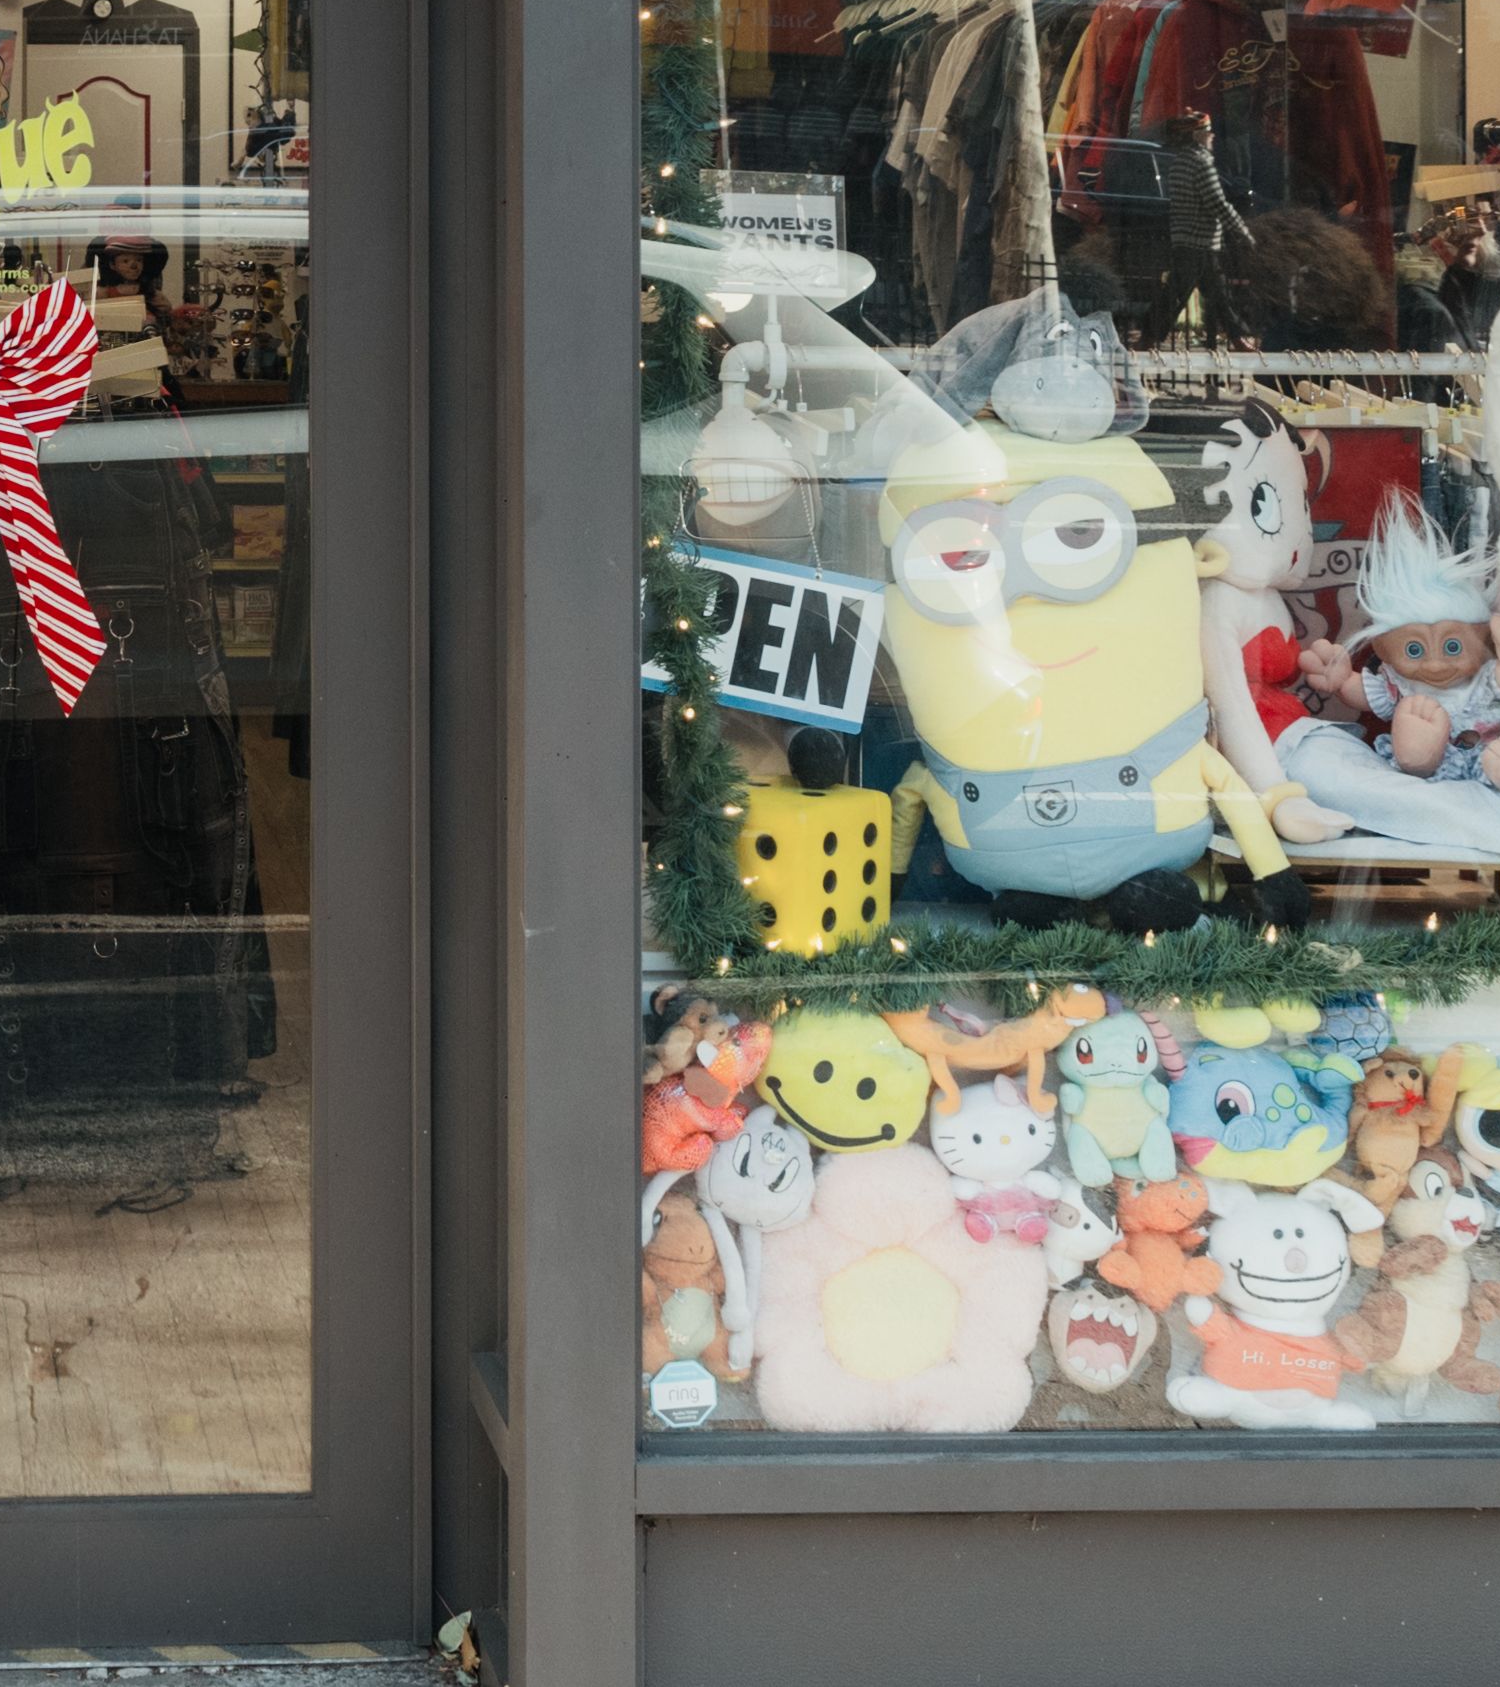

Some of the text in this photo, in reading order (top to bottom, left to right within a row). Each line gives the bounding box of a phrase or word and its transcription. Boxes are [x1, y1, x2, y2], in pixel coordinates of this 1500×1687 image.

[720, 215, 833, 232] WOMEN'S
[1241, 1349, 1337, 1371] Hi, Loser
[667, 1387, 700, 1404] ring
